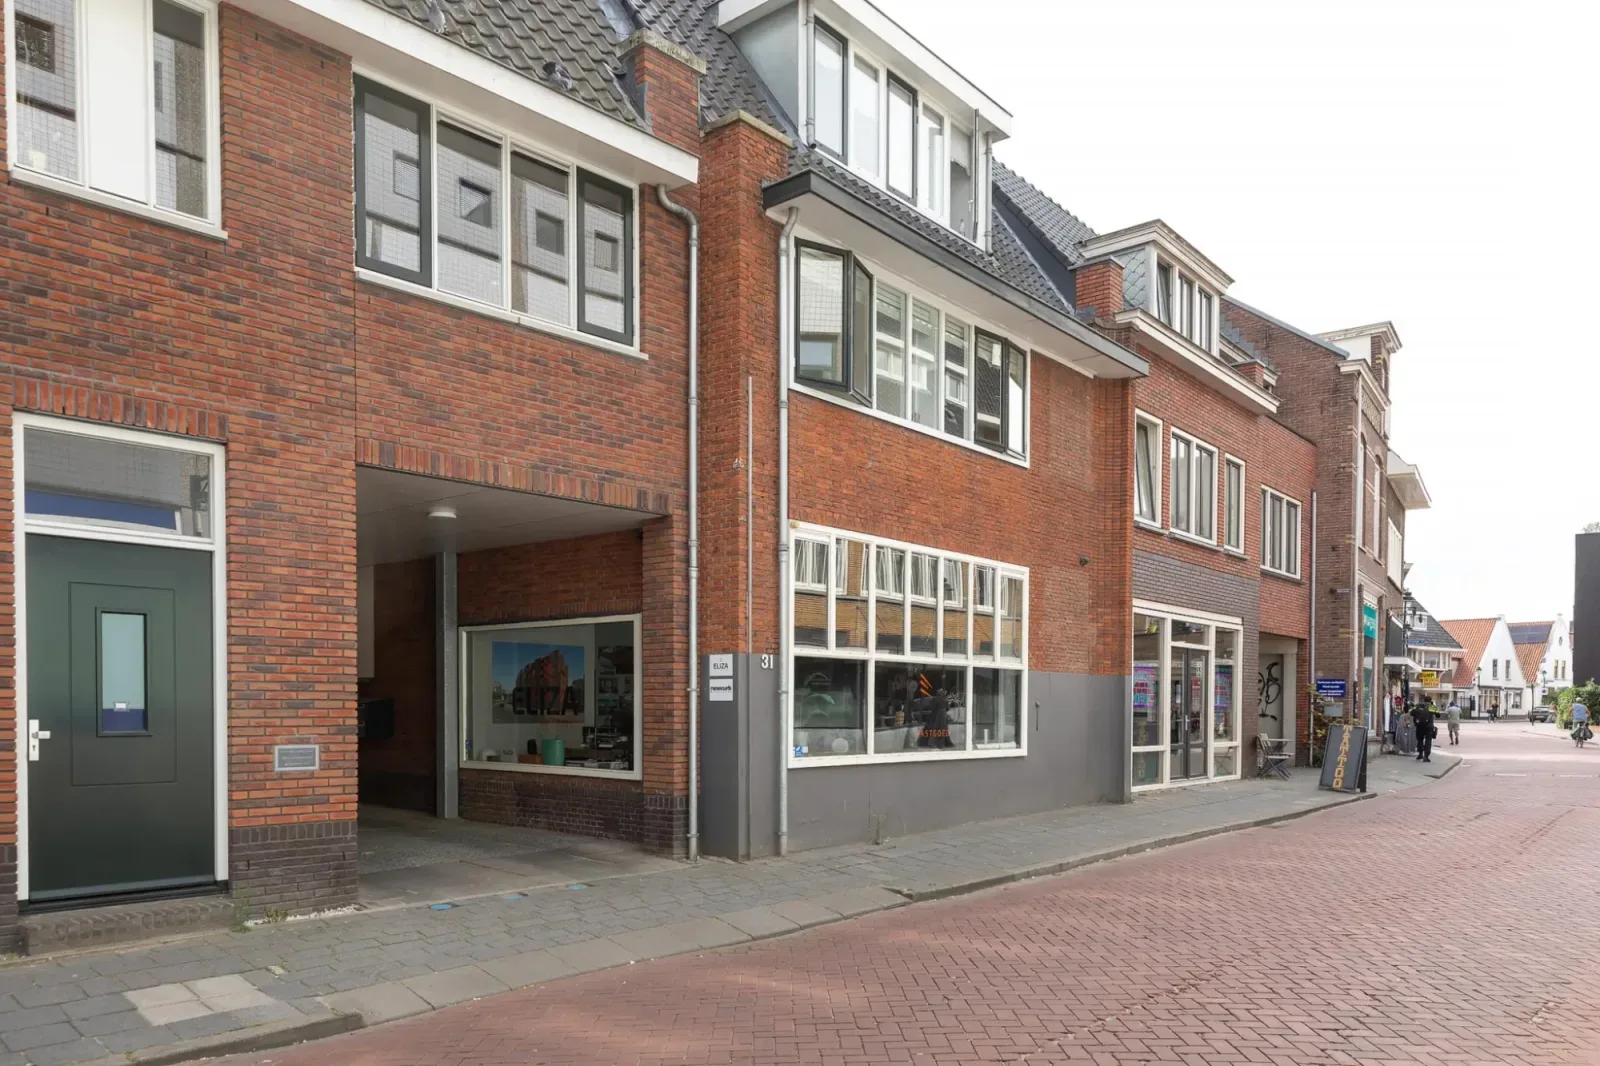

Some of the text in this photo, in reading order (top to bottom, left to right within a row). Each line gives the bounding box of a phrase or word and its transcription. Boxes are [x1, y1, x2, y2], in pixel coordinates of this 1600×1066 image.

[713, 662, 729, 670] ELIZA
[761, 654, 774, 669] 31
[512, 687, 579, 715] ELIZA
[1332, 725, 1353, 789] TATTOO
